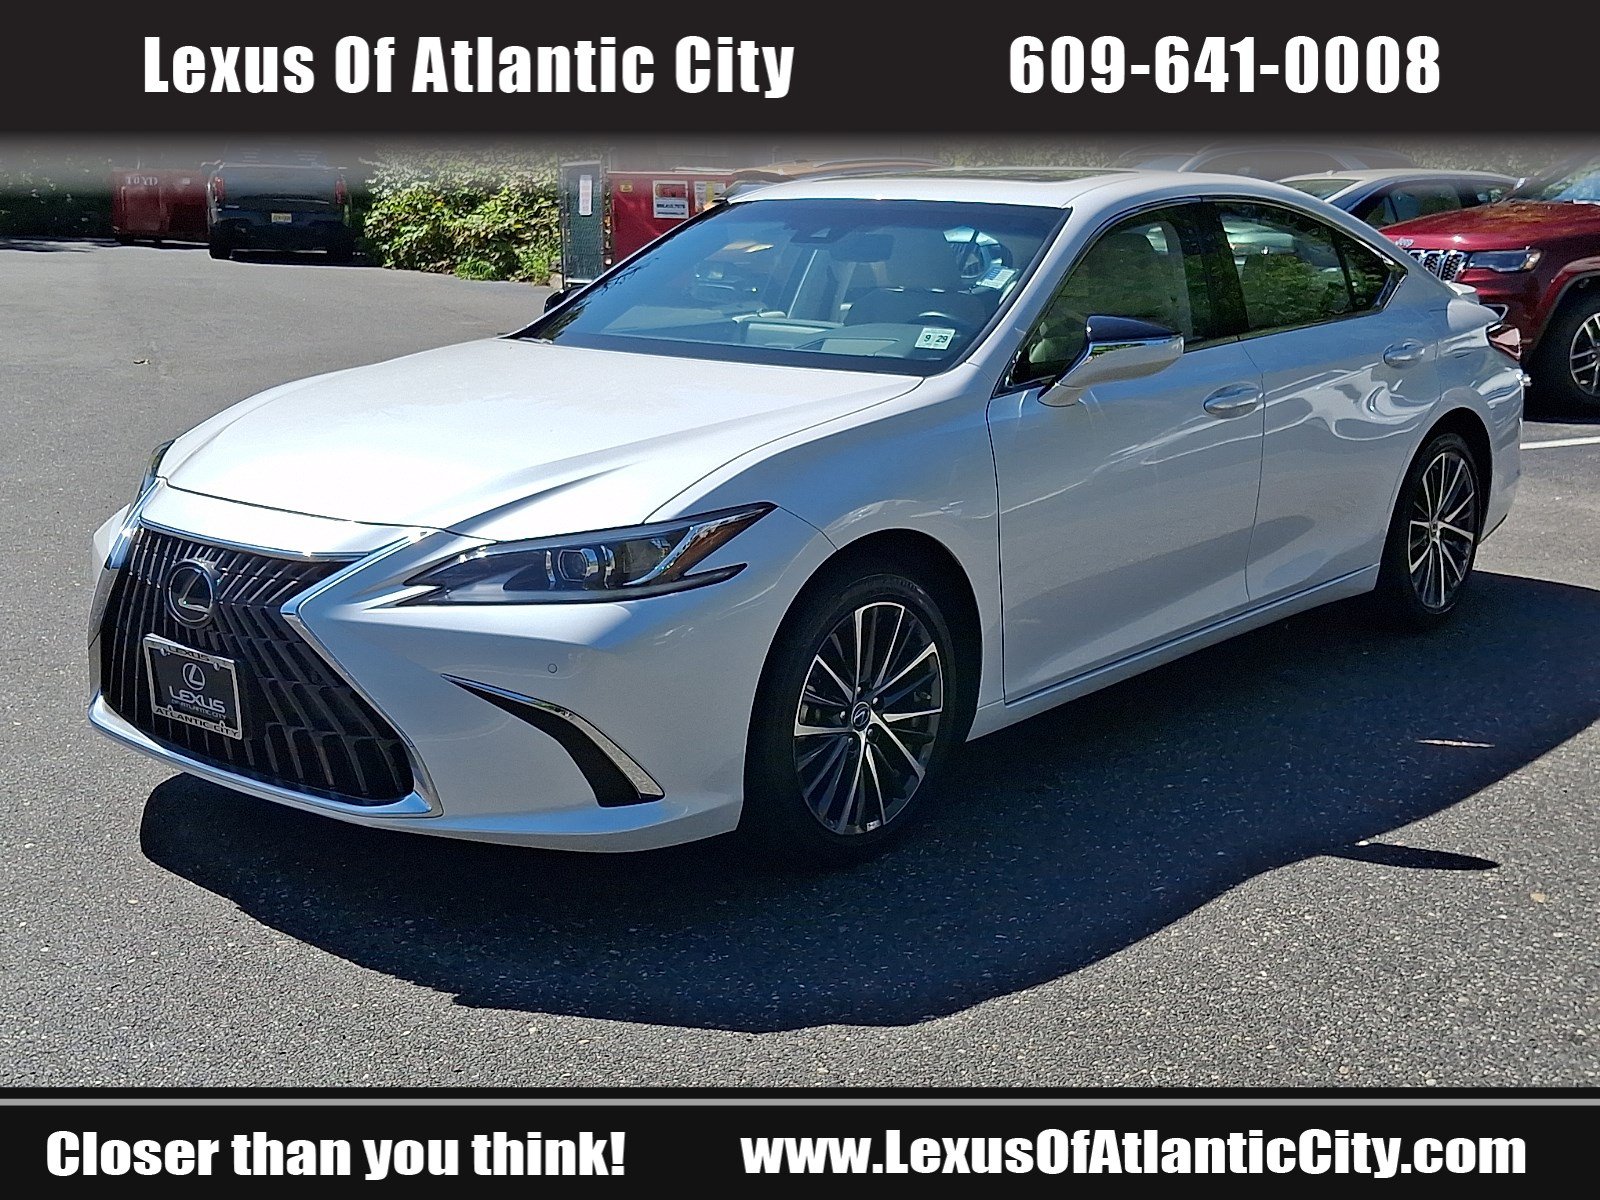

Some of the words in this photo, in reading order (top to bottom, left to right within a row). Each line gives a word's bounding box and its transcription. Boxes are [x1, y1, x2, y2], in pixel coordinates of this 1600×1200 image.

[924, 334, 932, 342] 9
[935, 334, 949, 343] 29
[169, 685, 226, 712] LEXUS
[156, 708, 210, 728] ATLANTIC
[214, 724, 239, 736] CITY
